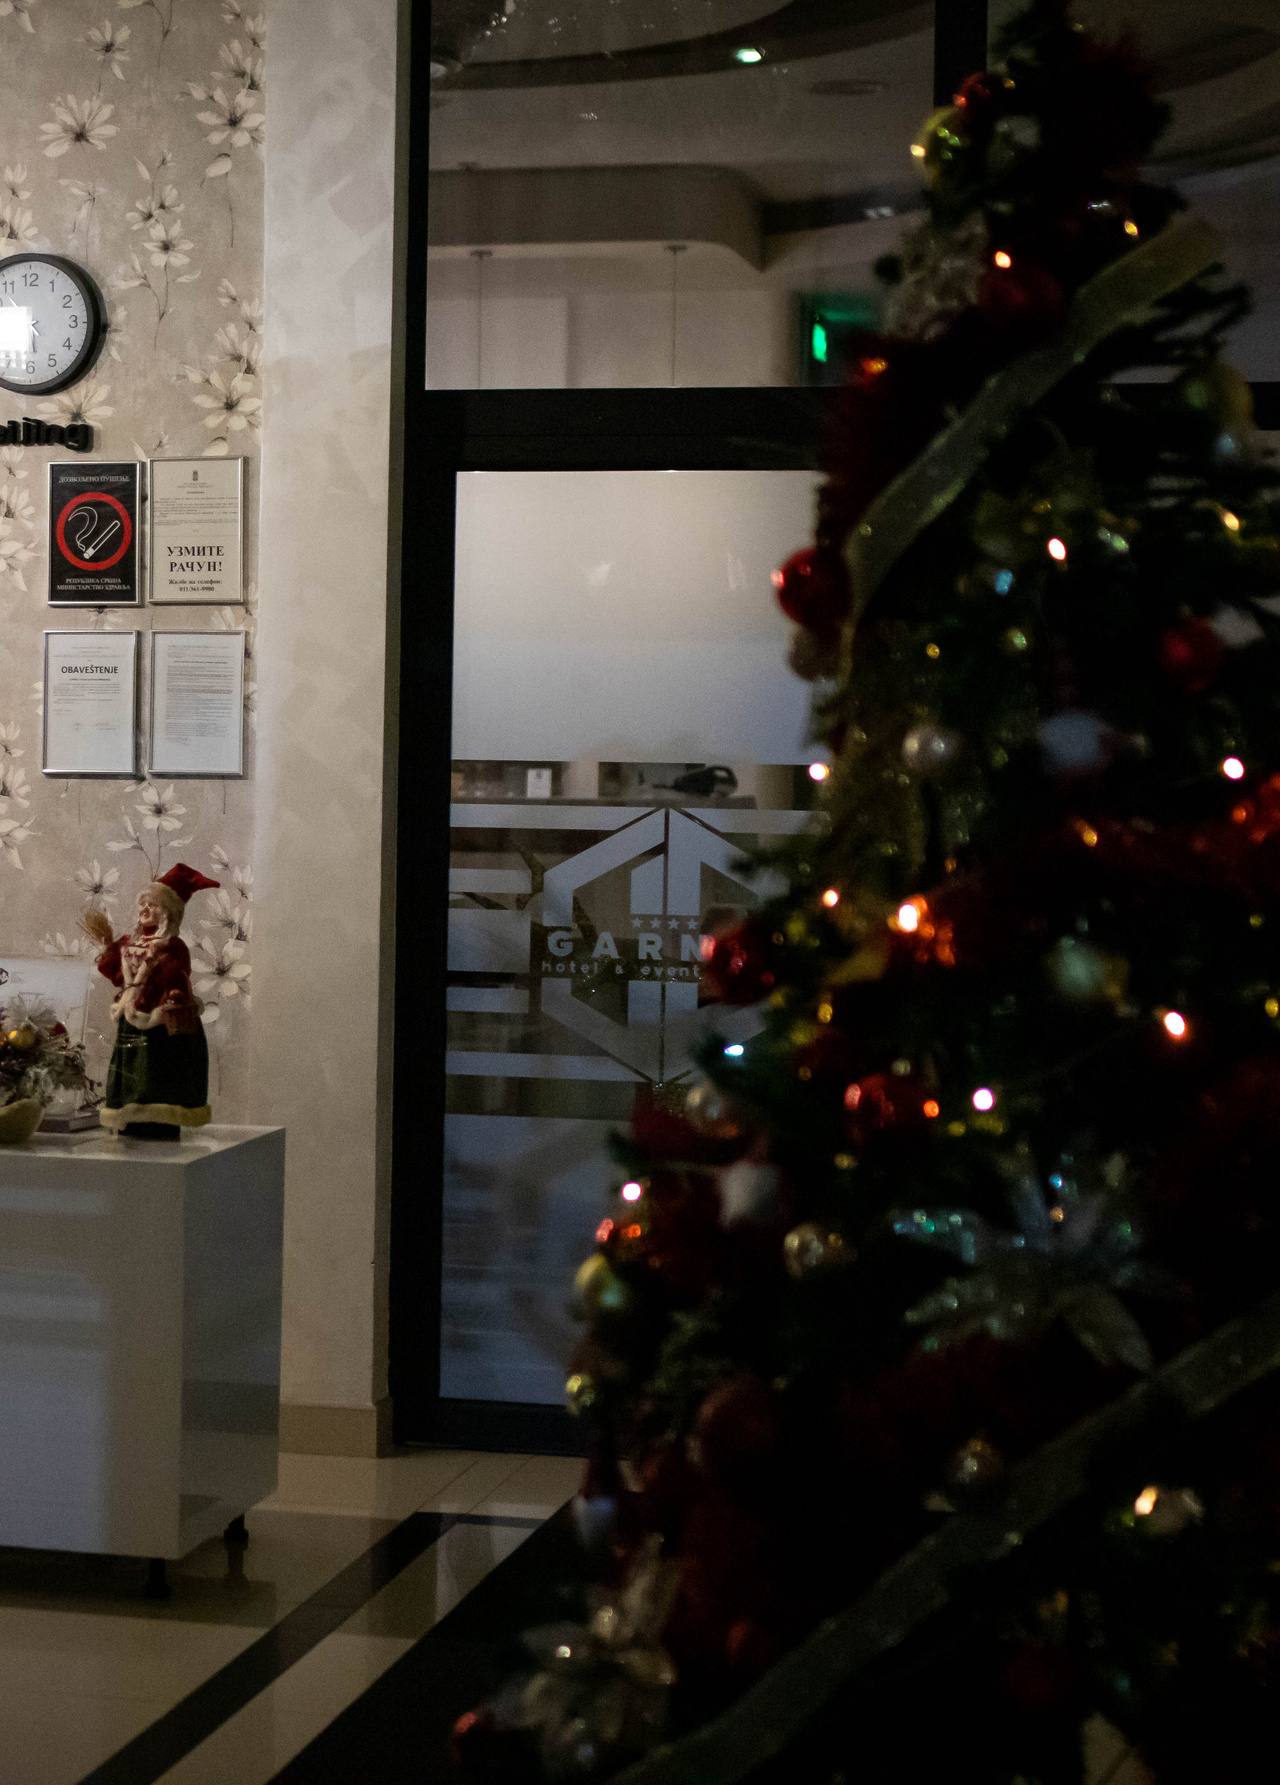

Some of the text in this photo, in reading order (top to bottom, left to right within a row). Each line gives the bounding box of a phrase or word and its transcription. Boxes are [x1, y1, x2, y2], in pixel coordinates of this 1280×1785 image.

[22, 273, 39, 287] 12
[50, 280, 55, 292] 1
[3, 281, 15, 294] 11
[63, 295, 72, 308] 2
[69, 315, 78, 328] 3
[63, 338, 72, 350] 4
[48, 354, 57, 367] 5
[26, 361, 35, 374] 6
[167, 546, 224, 556] УЗМИТЕ
[170, 561, 223, 572] РАЧУН!
[61, 665, 118, 674] OBAVEŠTENJE
[547, 930, 703, 962] GARN
[542, 961, 598, 974] hotel
[615, 966, 624, 975] &
